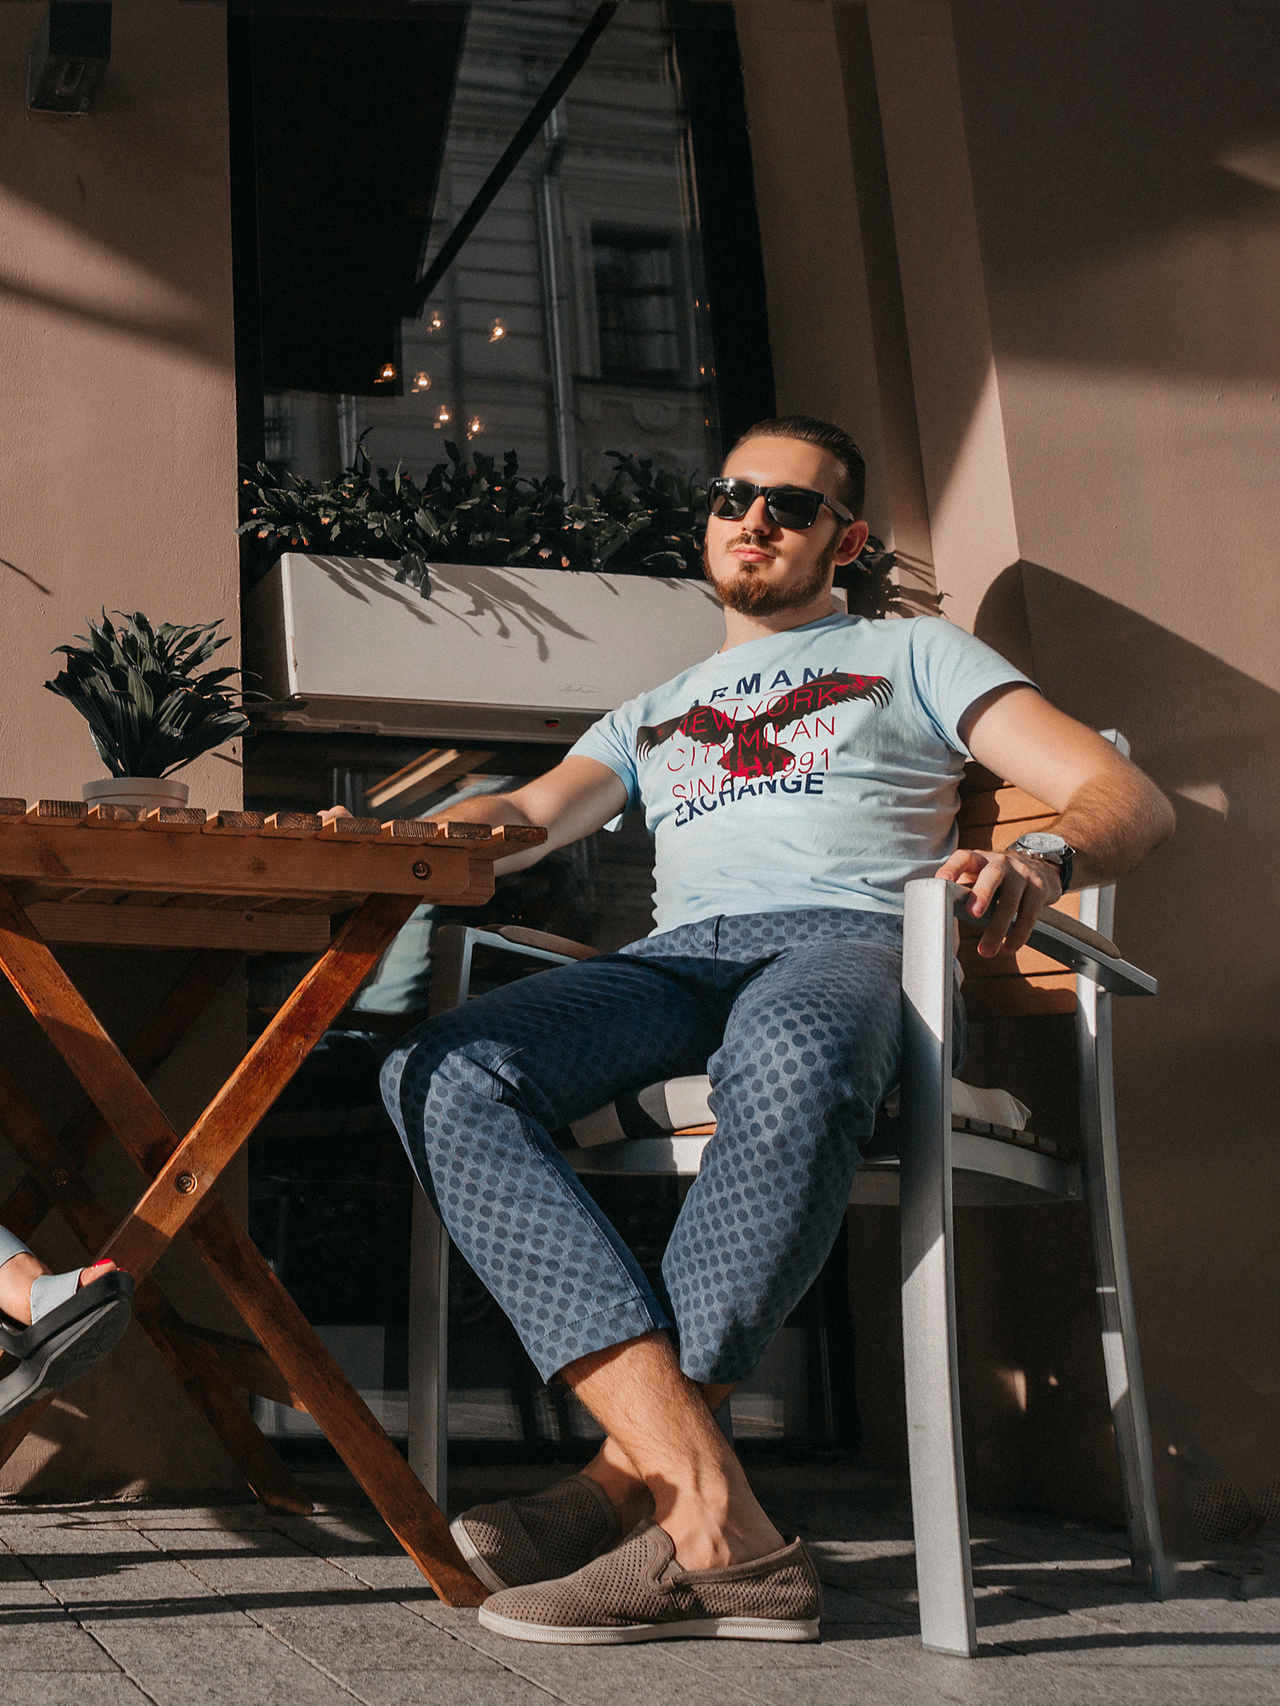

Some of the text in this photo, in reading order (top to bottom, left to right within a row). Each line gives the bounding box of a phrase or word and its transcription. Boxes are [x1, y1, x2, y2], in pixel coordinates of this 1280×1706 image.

[747, 685, 838, 721] YORK
[667, 716, 835, 772] CITY MILAN
[766, 748, 829, 780] 1991
[675, 772, 825, 827] EXCHANGE
